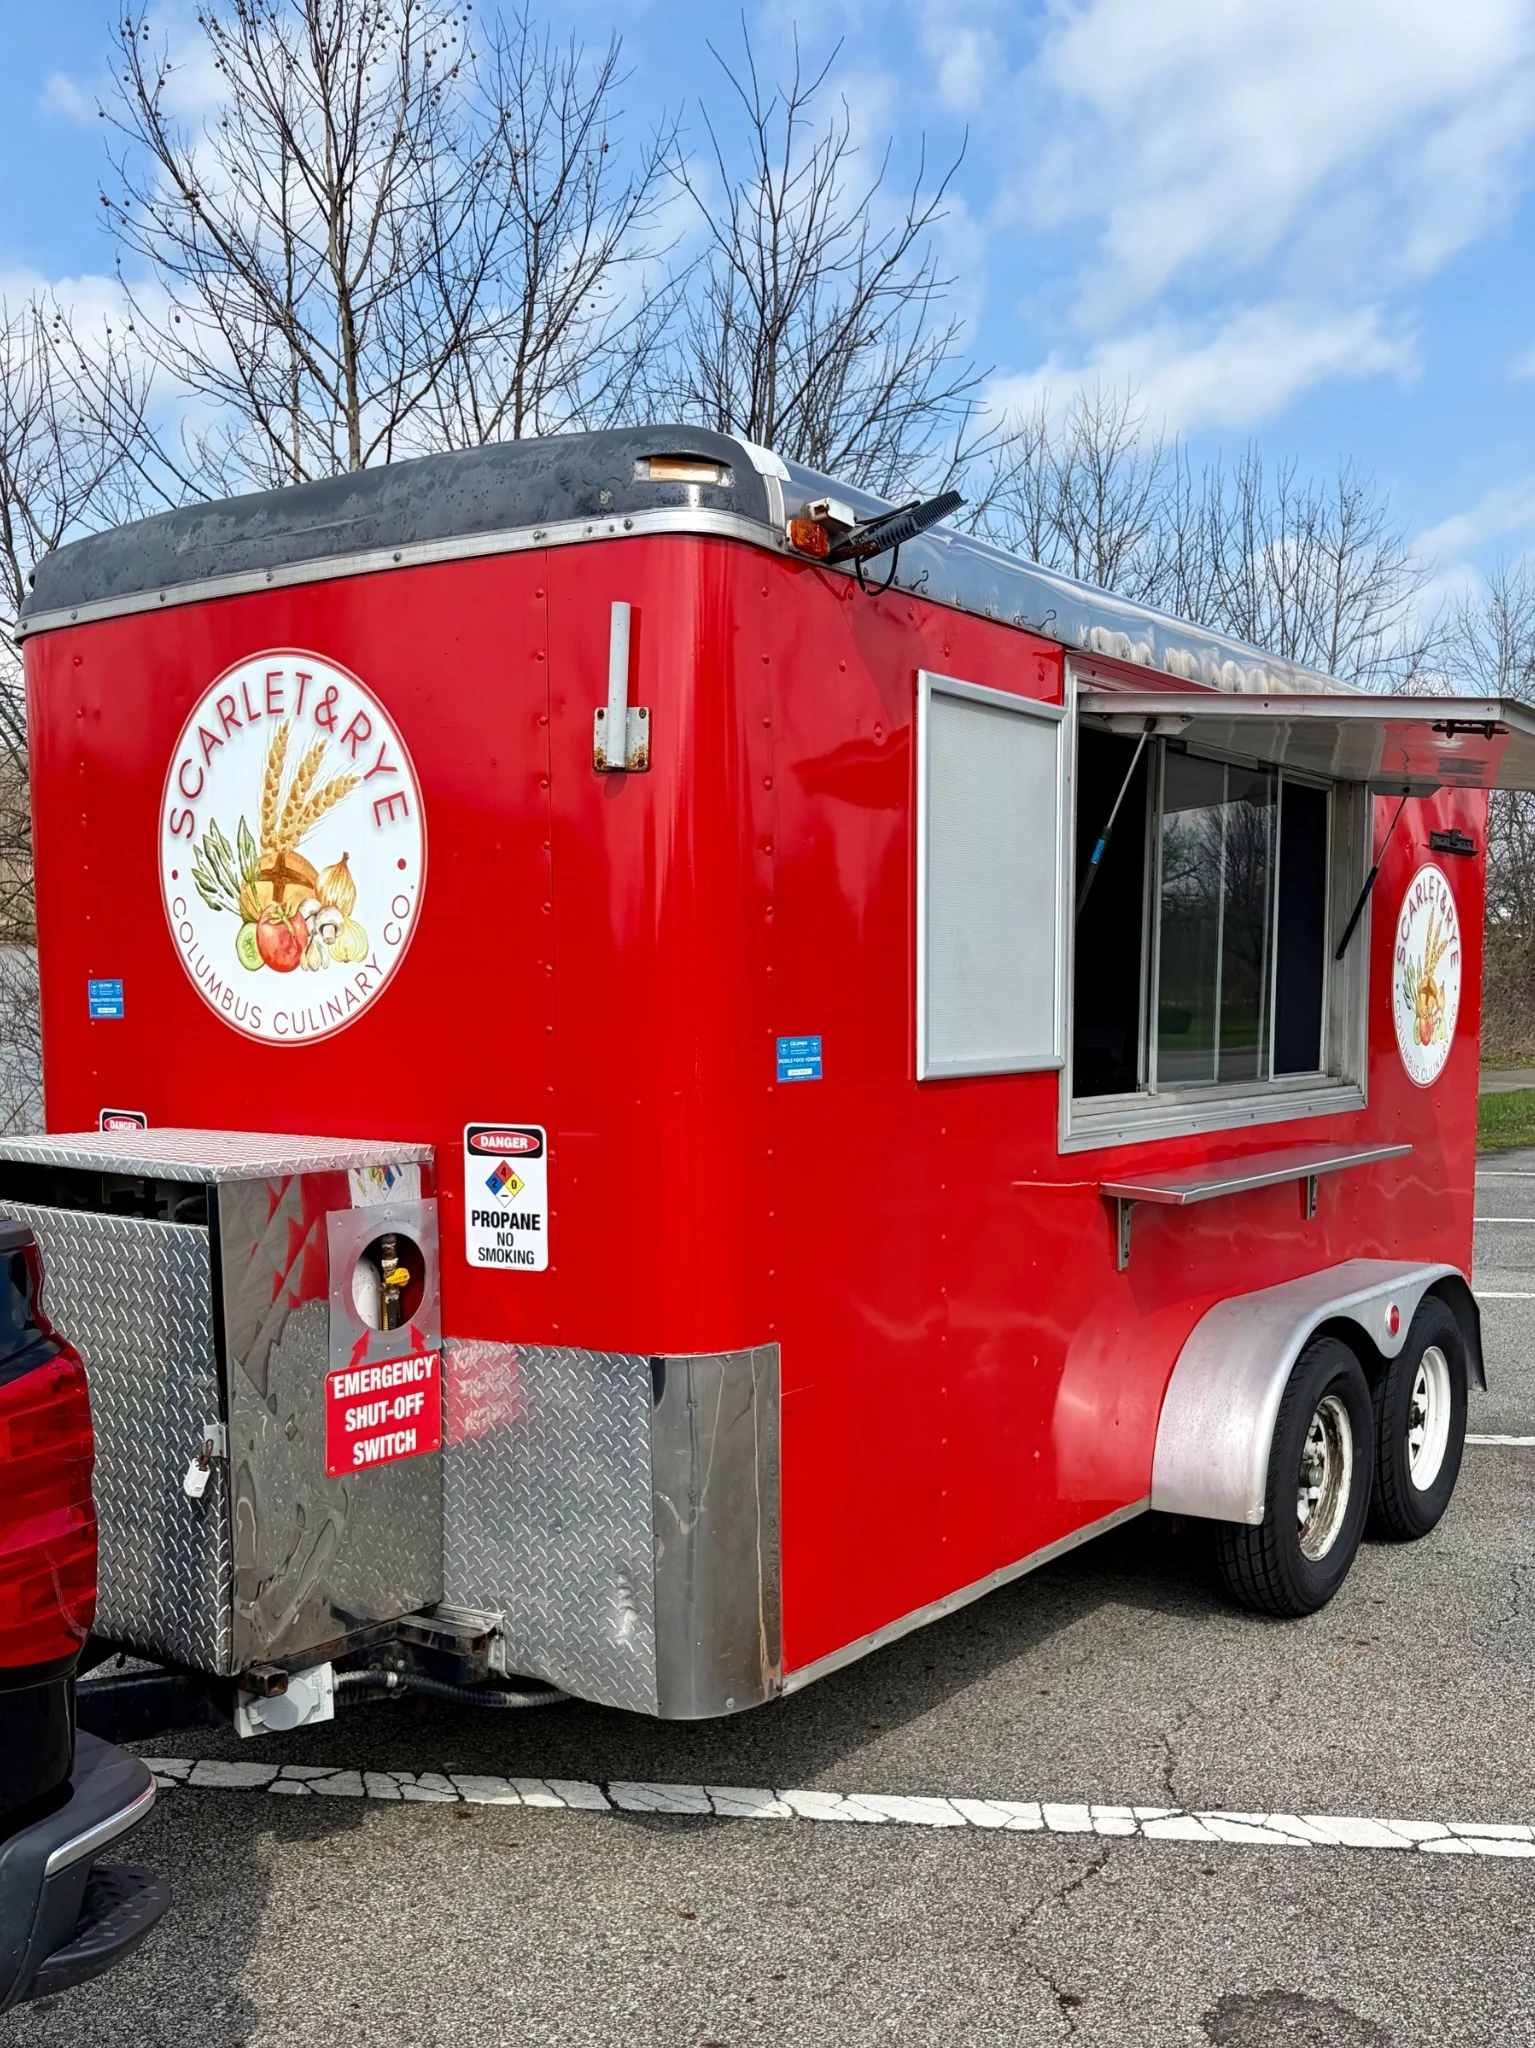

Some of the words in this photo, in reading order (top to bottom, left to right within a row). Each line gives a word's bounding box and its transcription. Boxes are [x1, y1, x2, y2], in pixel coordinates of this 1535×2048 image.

[172, 897, 262, 1030] COLUMBUS
[273, 953, 383, 1035] CULINARY
[383, 884, 416, 946] CO.
[1395, 1000, 1420, 1079] COLUMBUS
[480, 1135, 528, 1149] DANGER
[500, 1167, 507, 1177] 4
[491, 1178, 498, 1188] 2
[510, 1179, 517, 1190] 0
[471, 1209, 541, 1231] PROPANE
[497, 1231, 514, 1247] NO
[478, 1247, 535, 1265] SMOKING
[333, 1355, 435, 1399] EMERGENCY
[345, 1391, 425, 1432] SHUT-OFF
[353, 1428, 417, 1465] SWITCH
